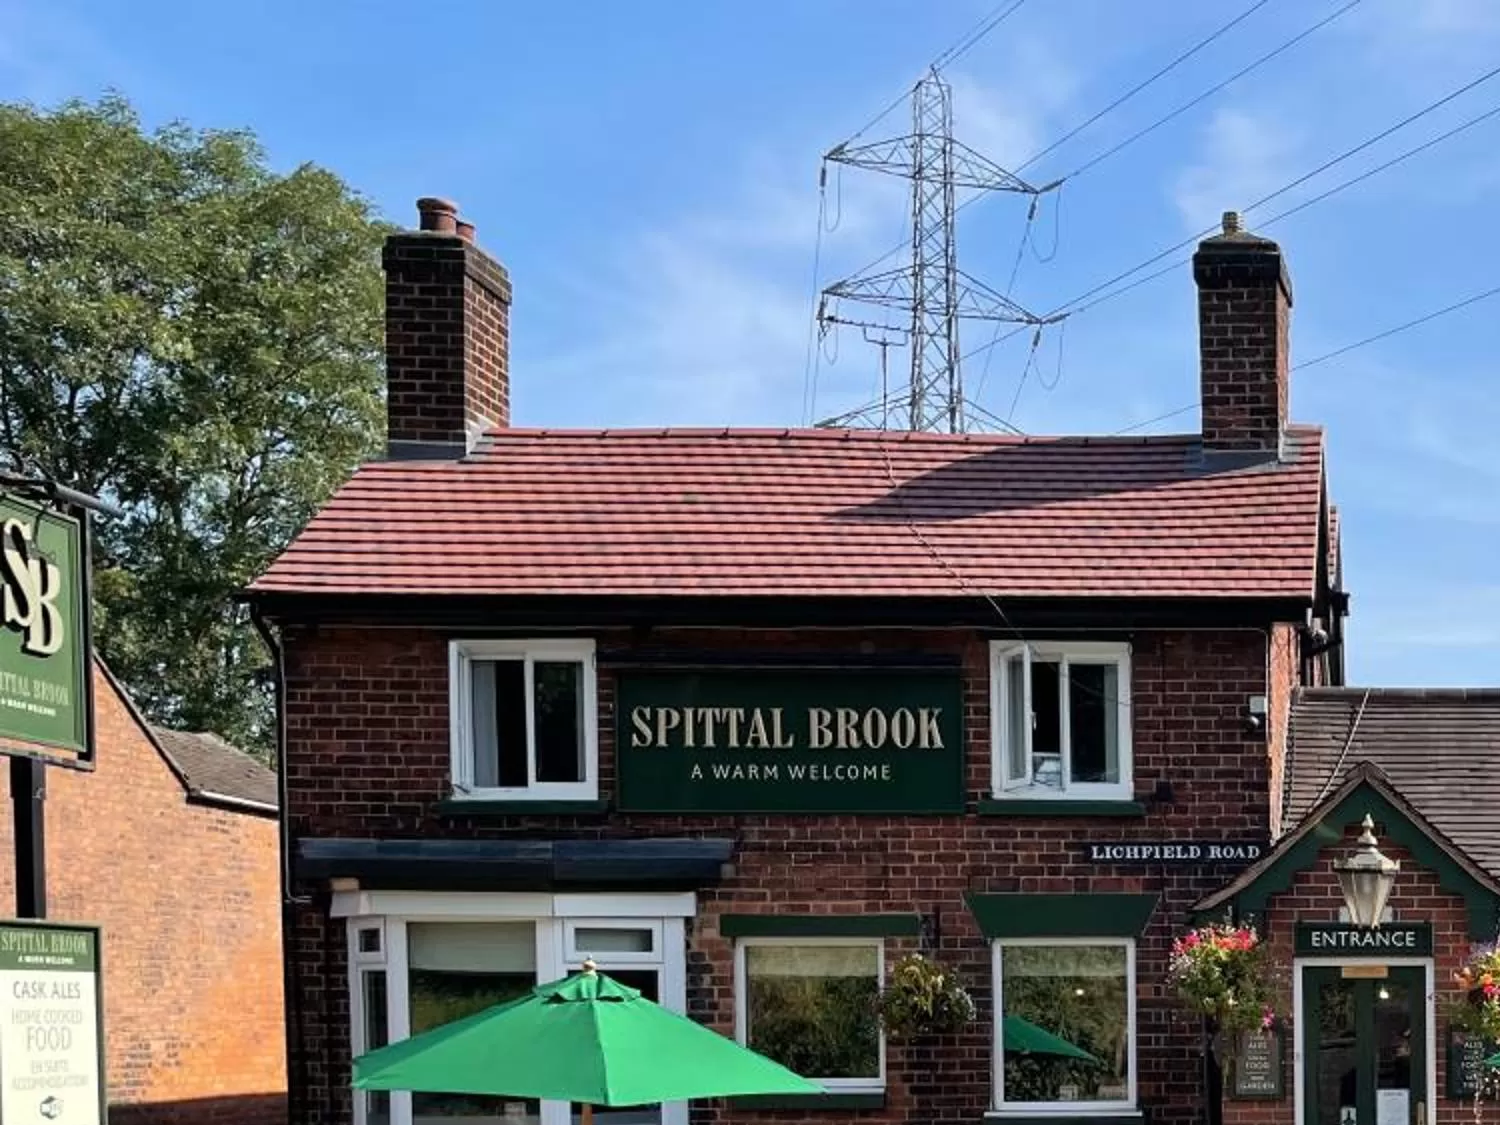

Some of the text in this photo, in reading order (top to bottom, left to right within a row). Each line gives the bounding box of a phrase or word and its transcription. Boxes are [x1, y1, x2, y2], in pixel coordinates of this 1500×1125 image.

[631, 706, 945, 749] SPITTAL BROOK
[691, 764, 892, 781] A WARM WELCOME
[1092, 845, 1261, 860] LICHFIELD ROAD
[1, 931, 88, 956] SPITTAL BROOK
[1311, 931, 1417, 947] ENTRANCE
[13, 980, 81, 999] CASK ALES
[26, 1026, 72, 1052] FOOD
